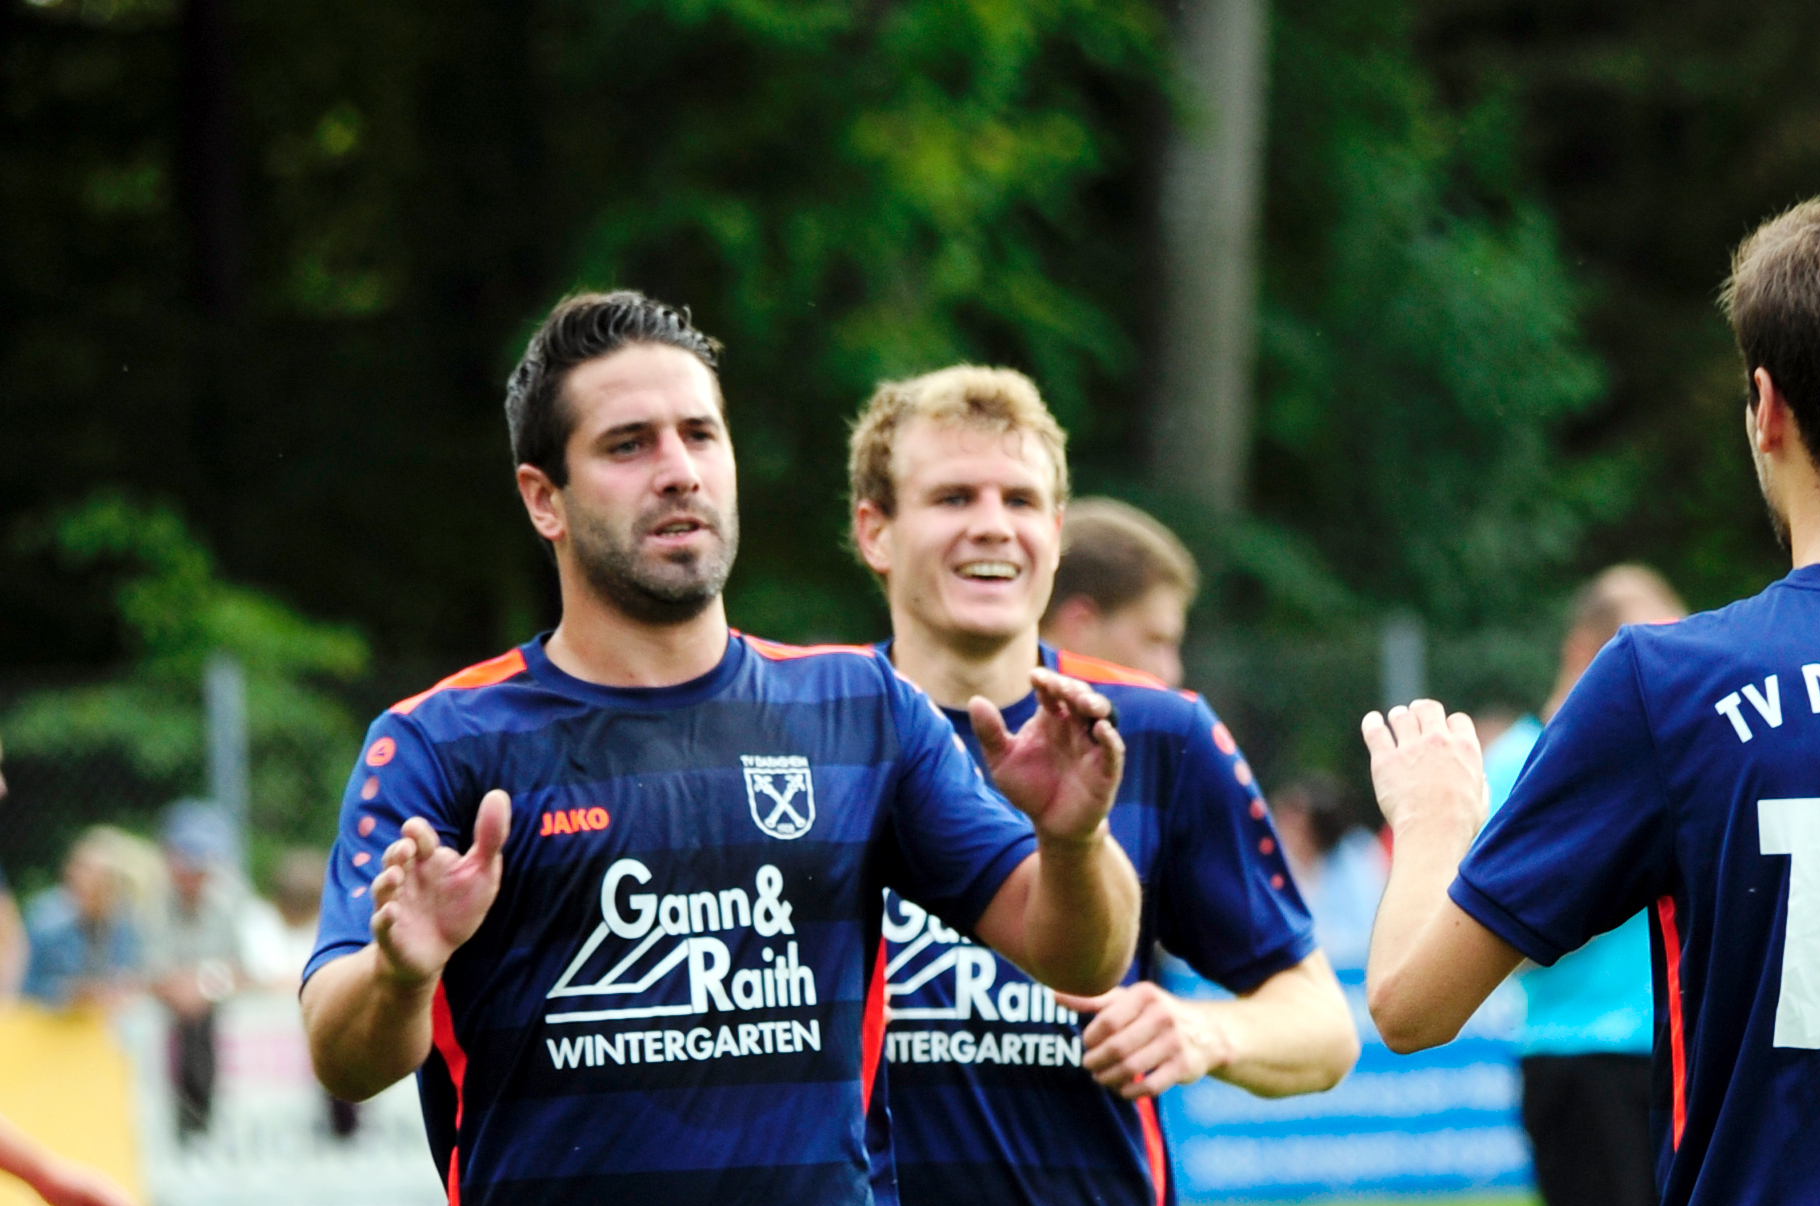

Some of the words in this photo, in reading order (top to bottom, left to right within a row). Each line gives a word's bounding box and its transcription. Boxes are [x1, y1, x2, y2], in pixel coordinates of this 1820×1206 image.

[1714, 674, 1783, 743] TV
[540, 806, 611, 837] JAKO
[687, 940, 817, 1015] Raith
[547, 1018, 821, 1070] WINTERGARTEN
